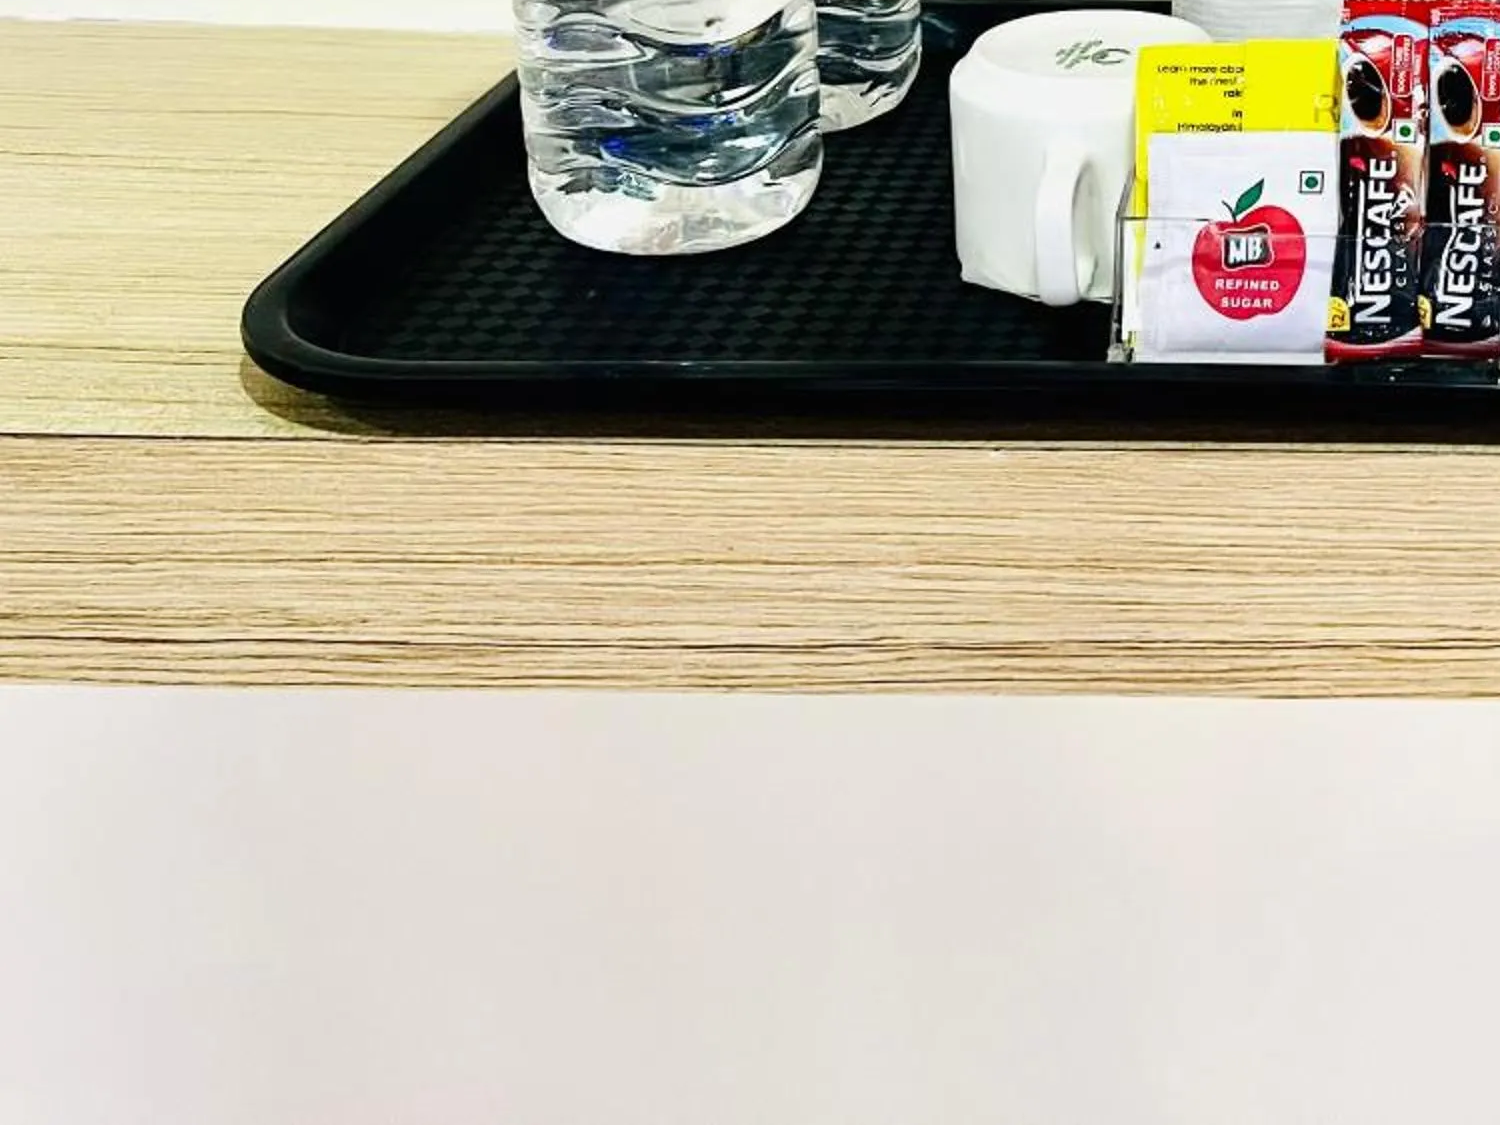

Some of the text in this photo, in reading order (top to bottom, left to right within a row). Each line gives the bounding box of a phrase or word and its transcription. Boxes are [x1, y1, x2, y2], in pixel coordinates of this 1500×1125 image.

[1228, 236, 1263, 264] MB
[1215, 278, 1280, 291] REFINED
[1221, 296, 1273, 309] SUGAR
